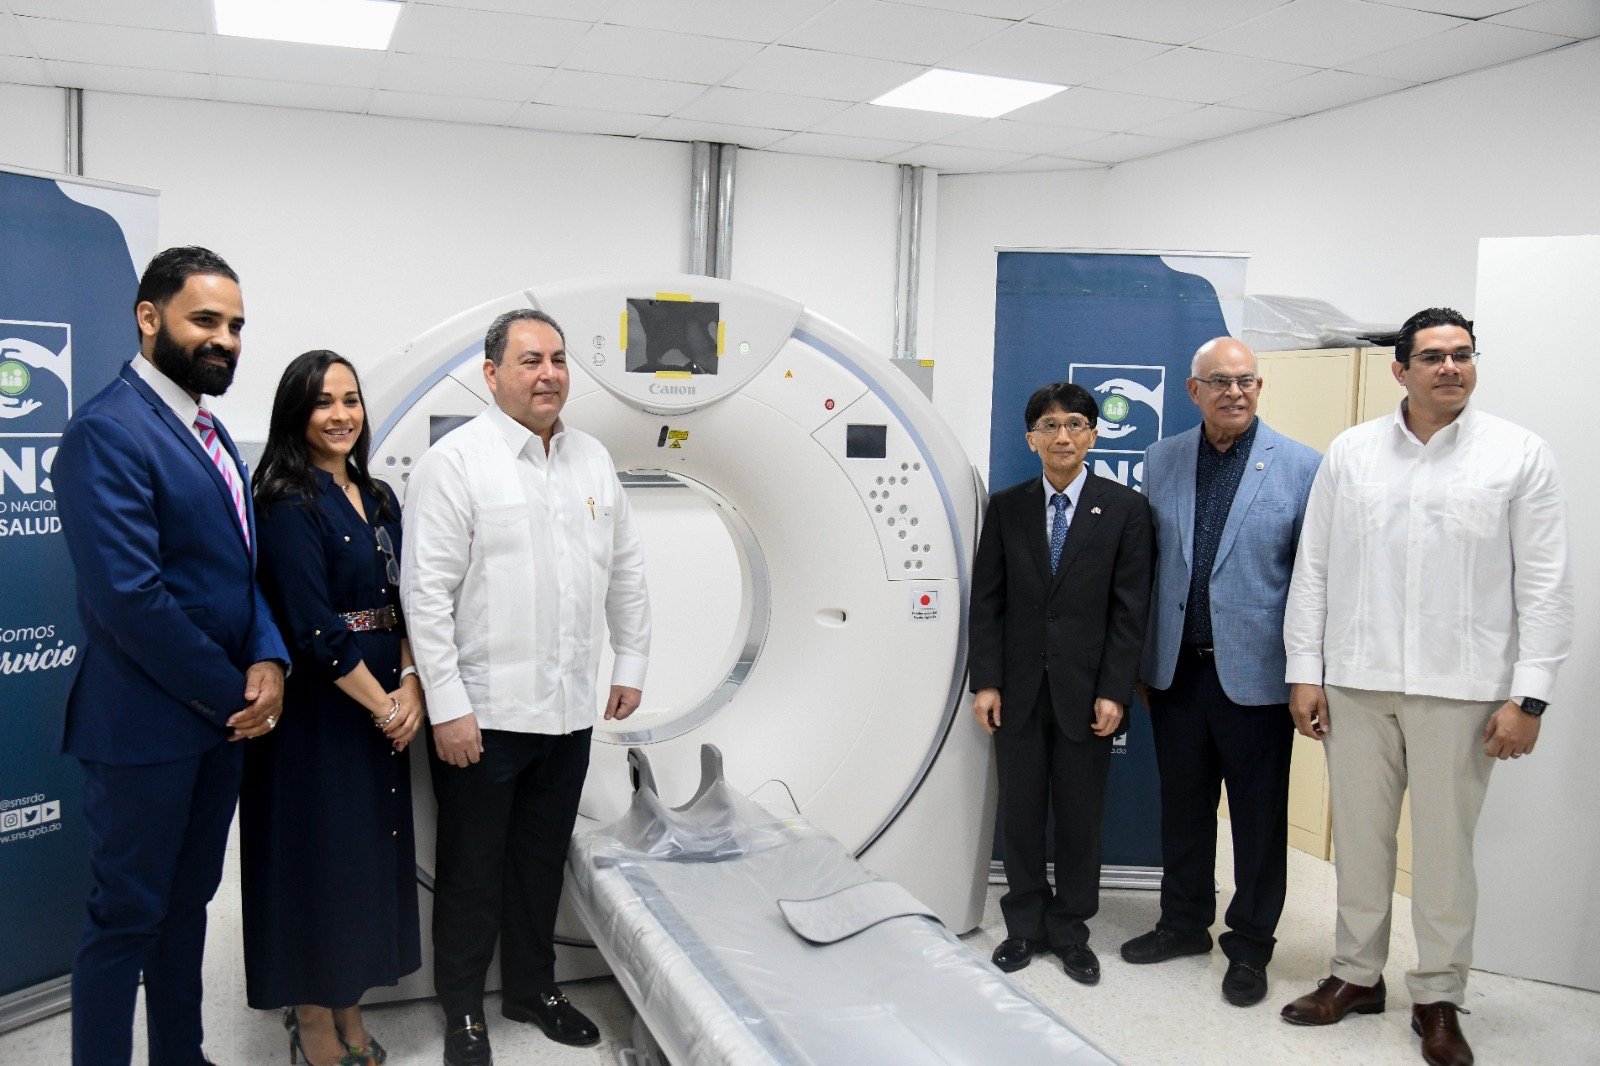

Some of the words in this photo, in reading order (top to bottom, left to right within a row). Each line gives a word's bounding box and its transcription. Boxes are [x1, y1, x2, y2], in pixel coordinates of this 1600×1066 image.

[649, 383, 696, 395] Canon
[0, 516, 62, 537] SALUD
[0, 625, 56, 643] omos
[0, 639, 77, 675] rvicio
[0, 793, 45, 810] @snsrdo
